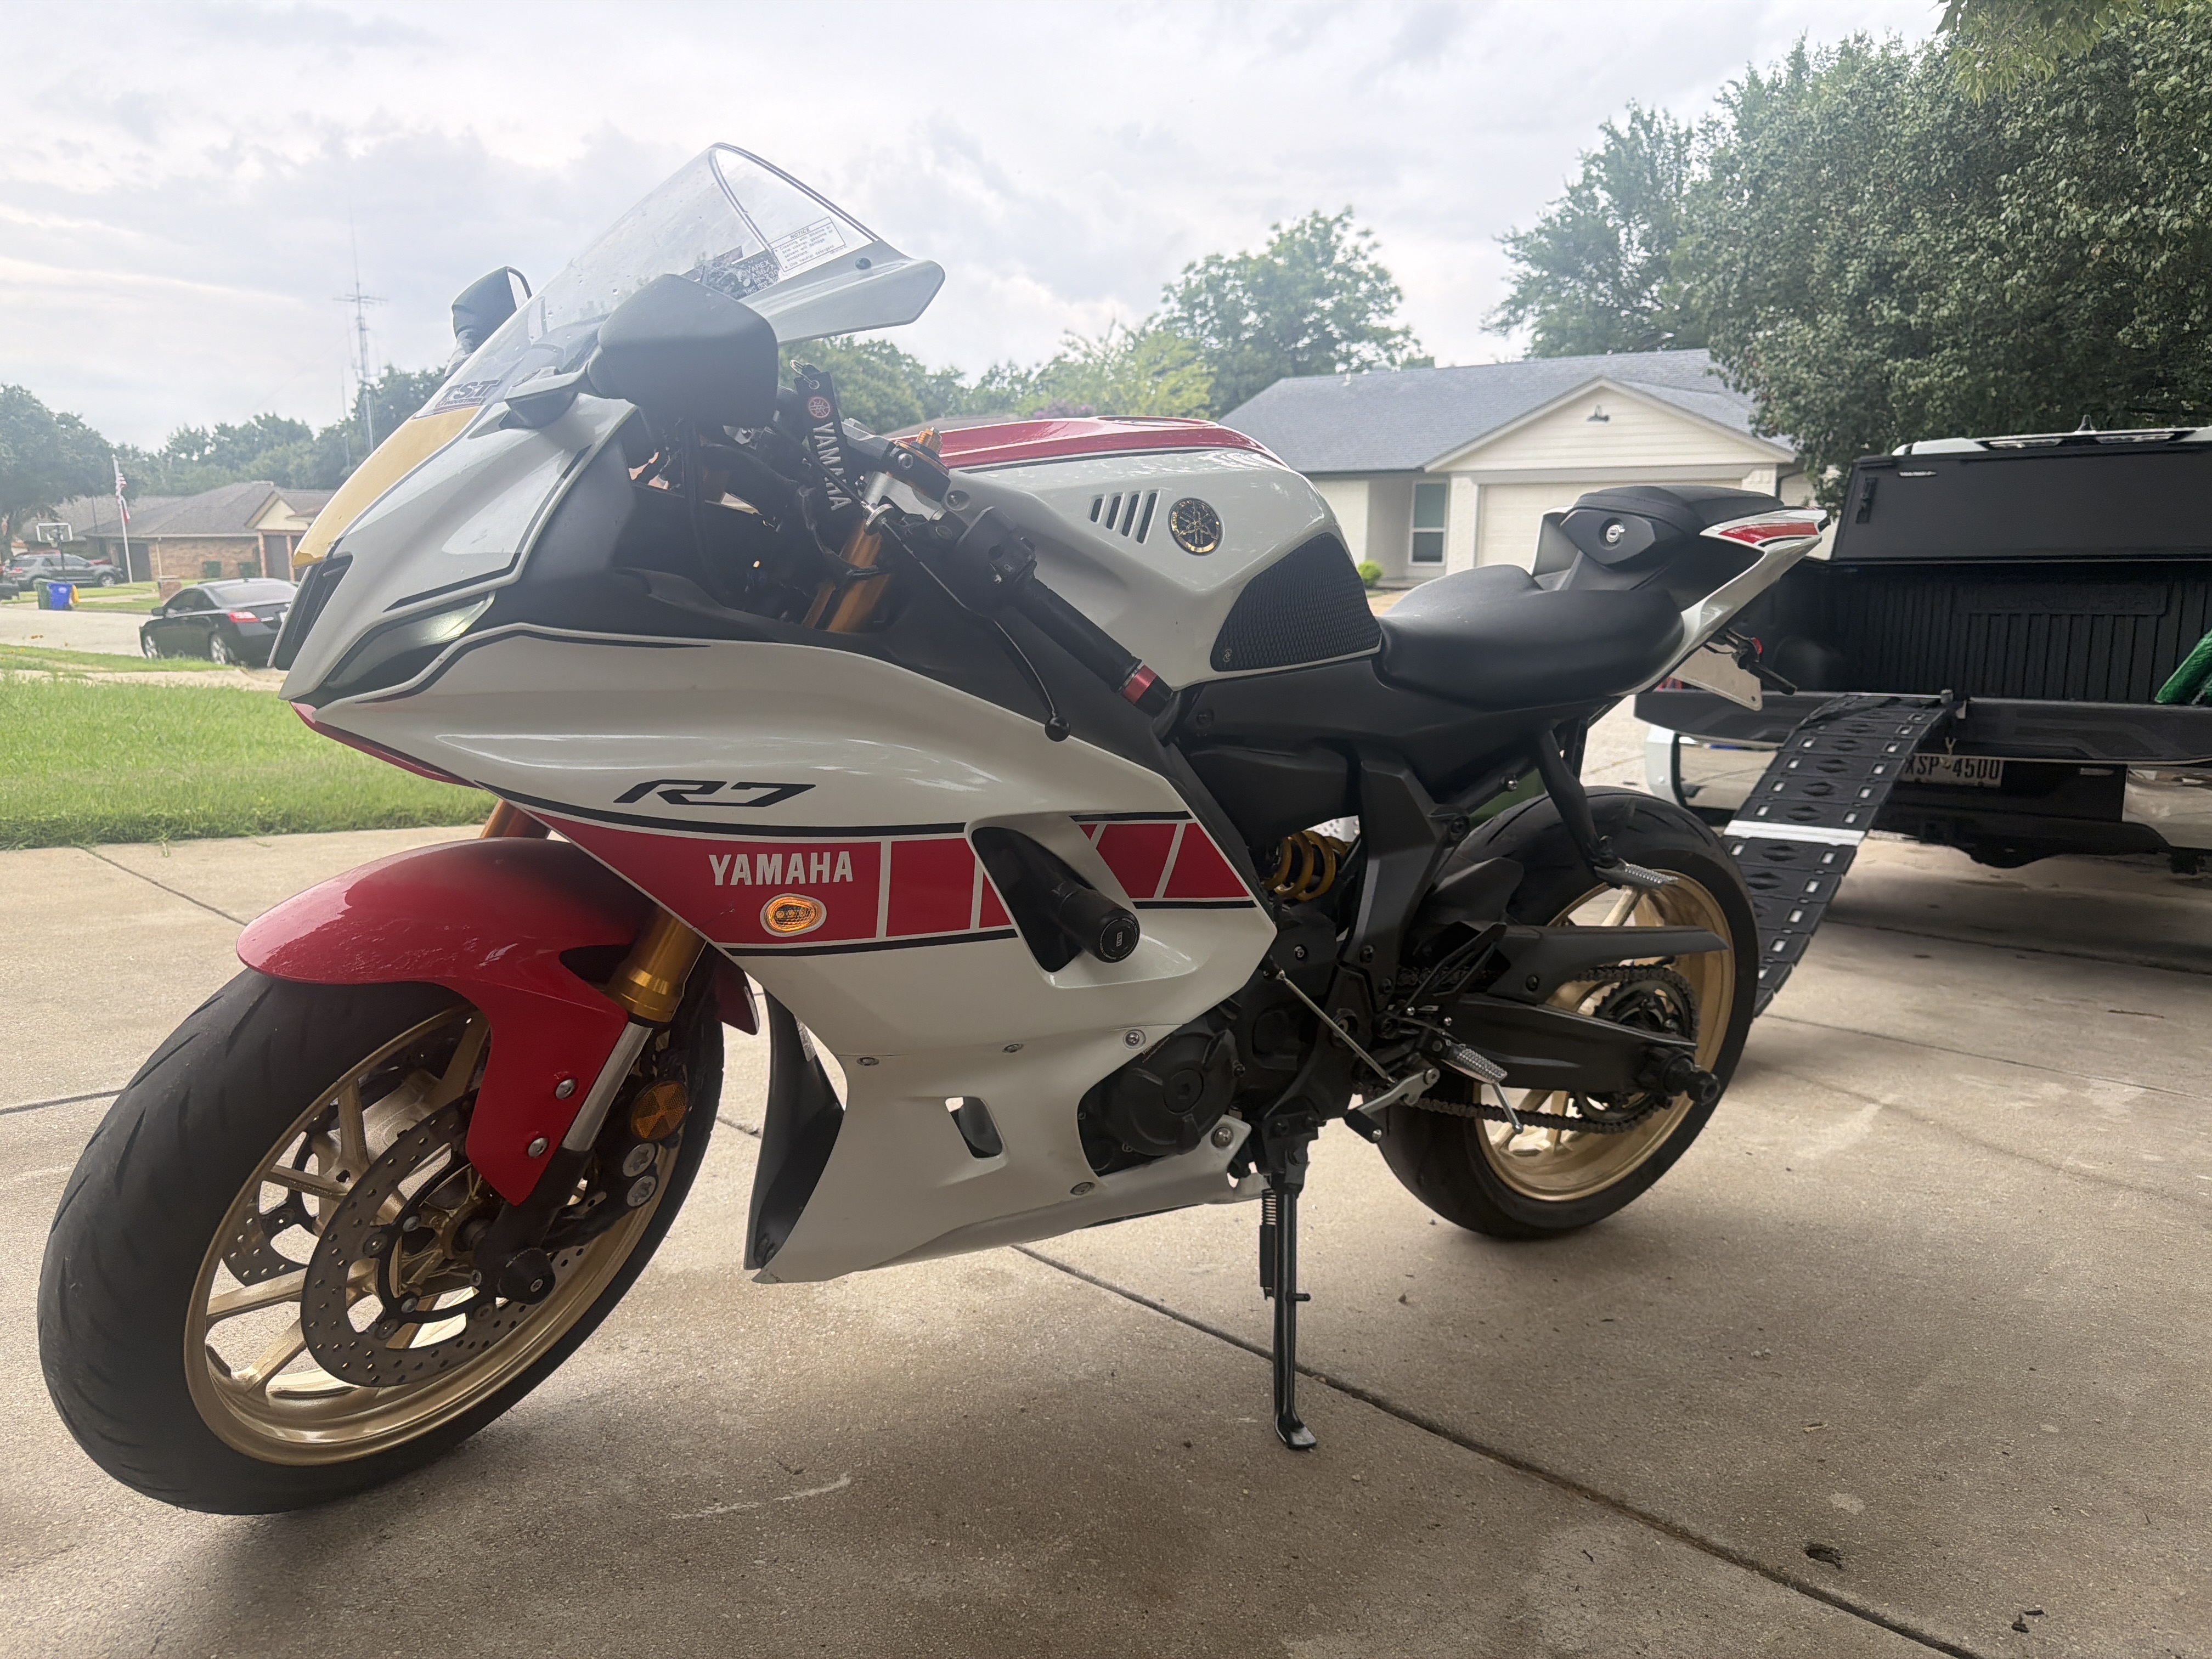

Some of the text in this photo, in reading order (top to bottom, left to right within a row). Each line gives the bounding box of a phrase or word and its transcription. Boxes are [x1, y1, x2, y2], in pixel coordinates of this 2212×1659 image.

[790, 227, 810, 239] NOTICE
[785, 250, 799, 258] solvent
[809, 238, 825, 247] damage
[815, 245, 834, 256] detergent
[738, 259, 771, 277] OVAREX
[752, 264, 774, 278] AS6/7
[443, 380, 500, 399] TST
[613, 778, 816, 807] R7
[708, 850, 853, 886] YAMAHA
